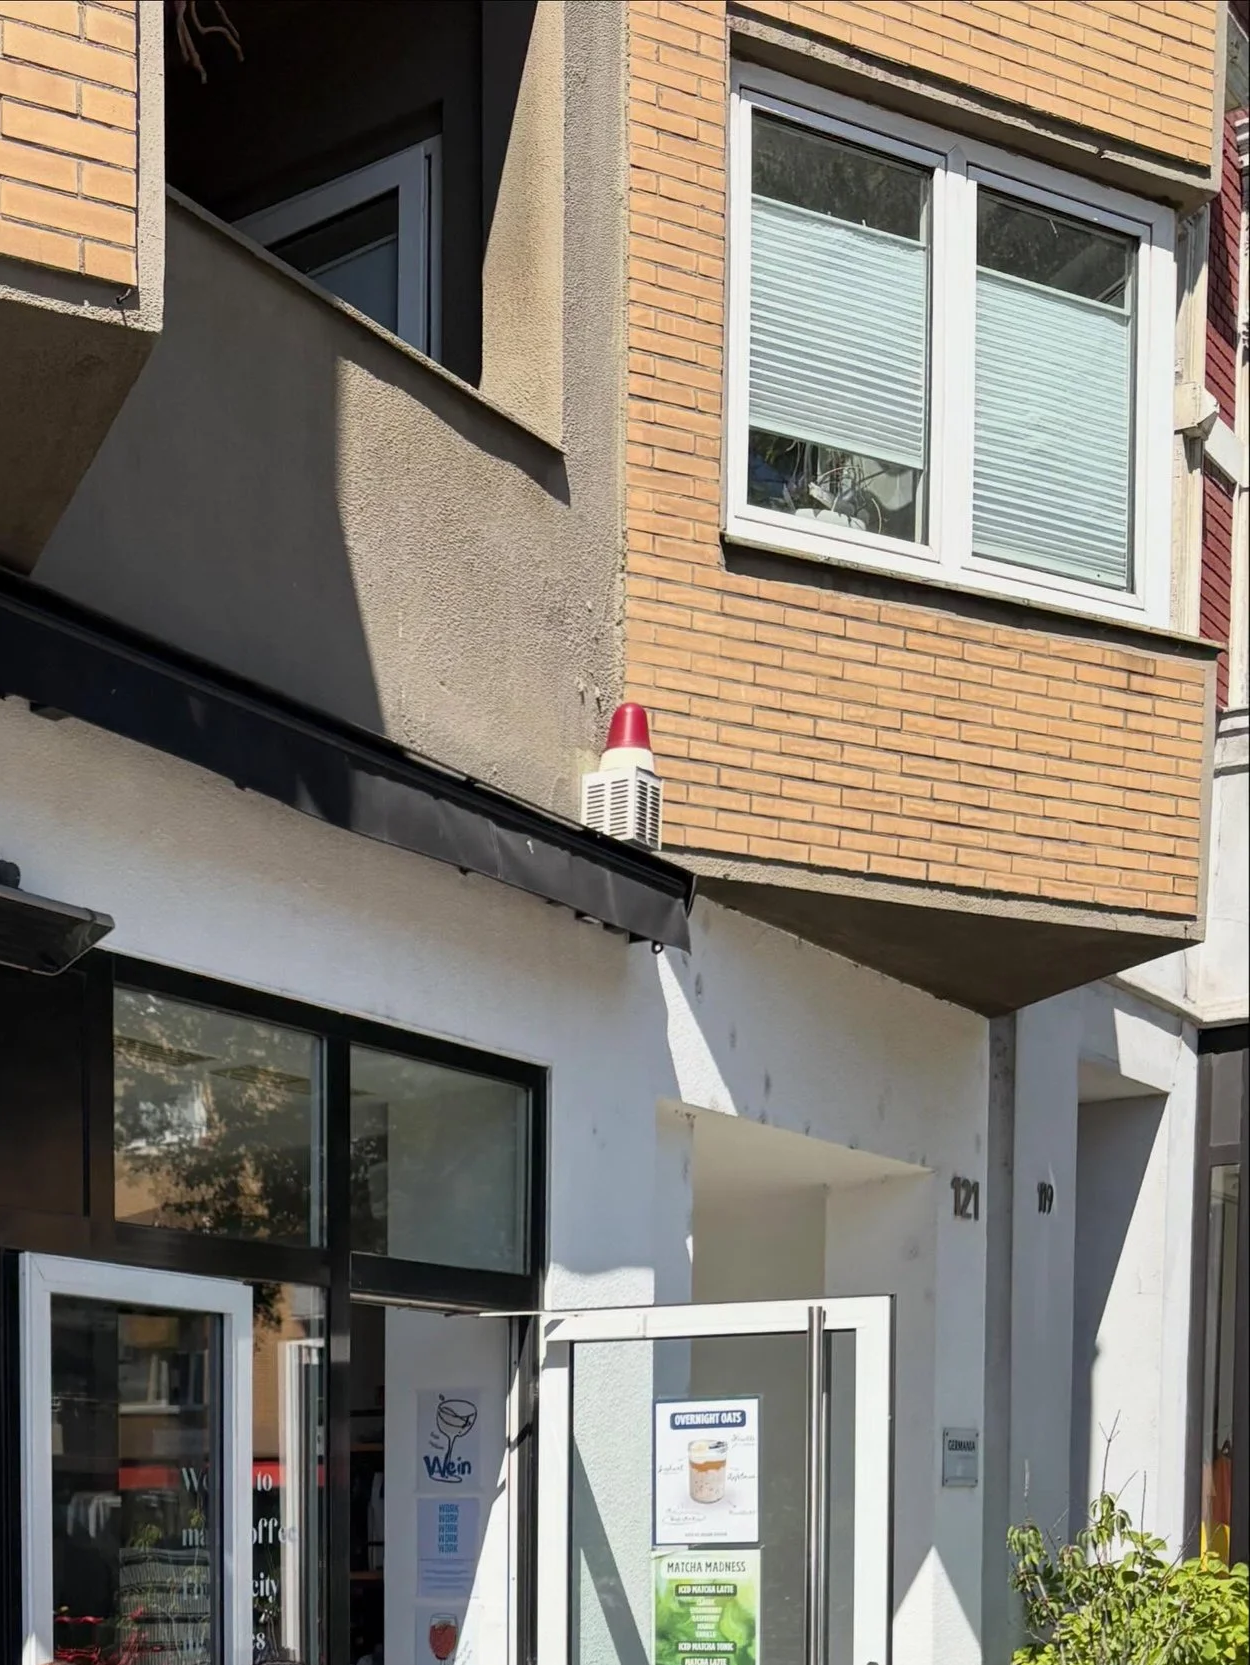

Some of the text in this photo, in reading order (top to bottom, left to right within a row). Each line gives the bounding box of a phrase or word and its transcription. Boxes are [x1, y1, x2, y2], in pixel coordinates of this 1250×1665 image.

[951, 1176, 979, 1220] 121
[674, 1411, 742, 1425] OVERNIGHT OATS
[423, 1455, 472, 1478] Wein
[667, 1561, 747, 1573] MATCHA MADNESS
